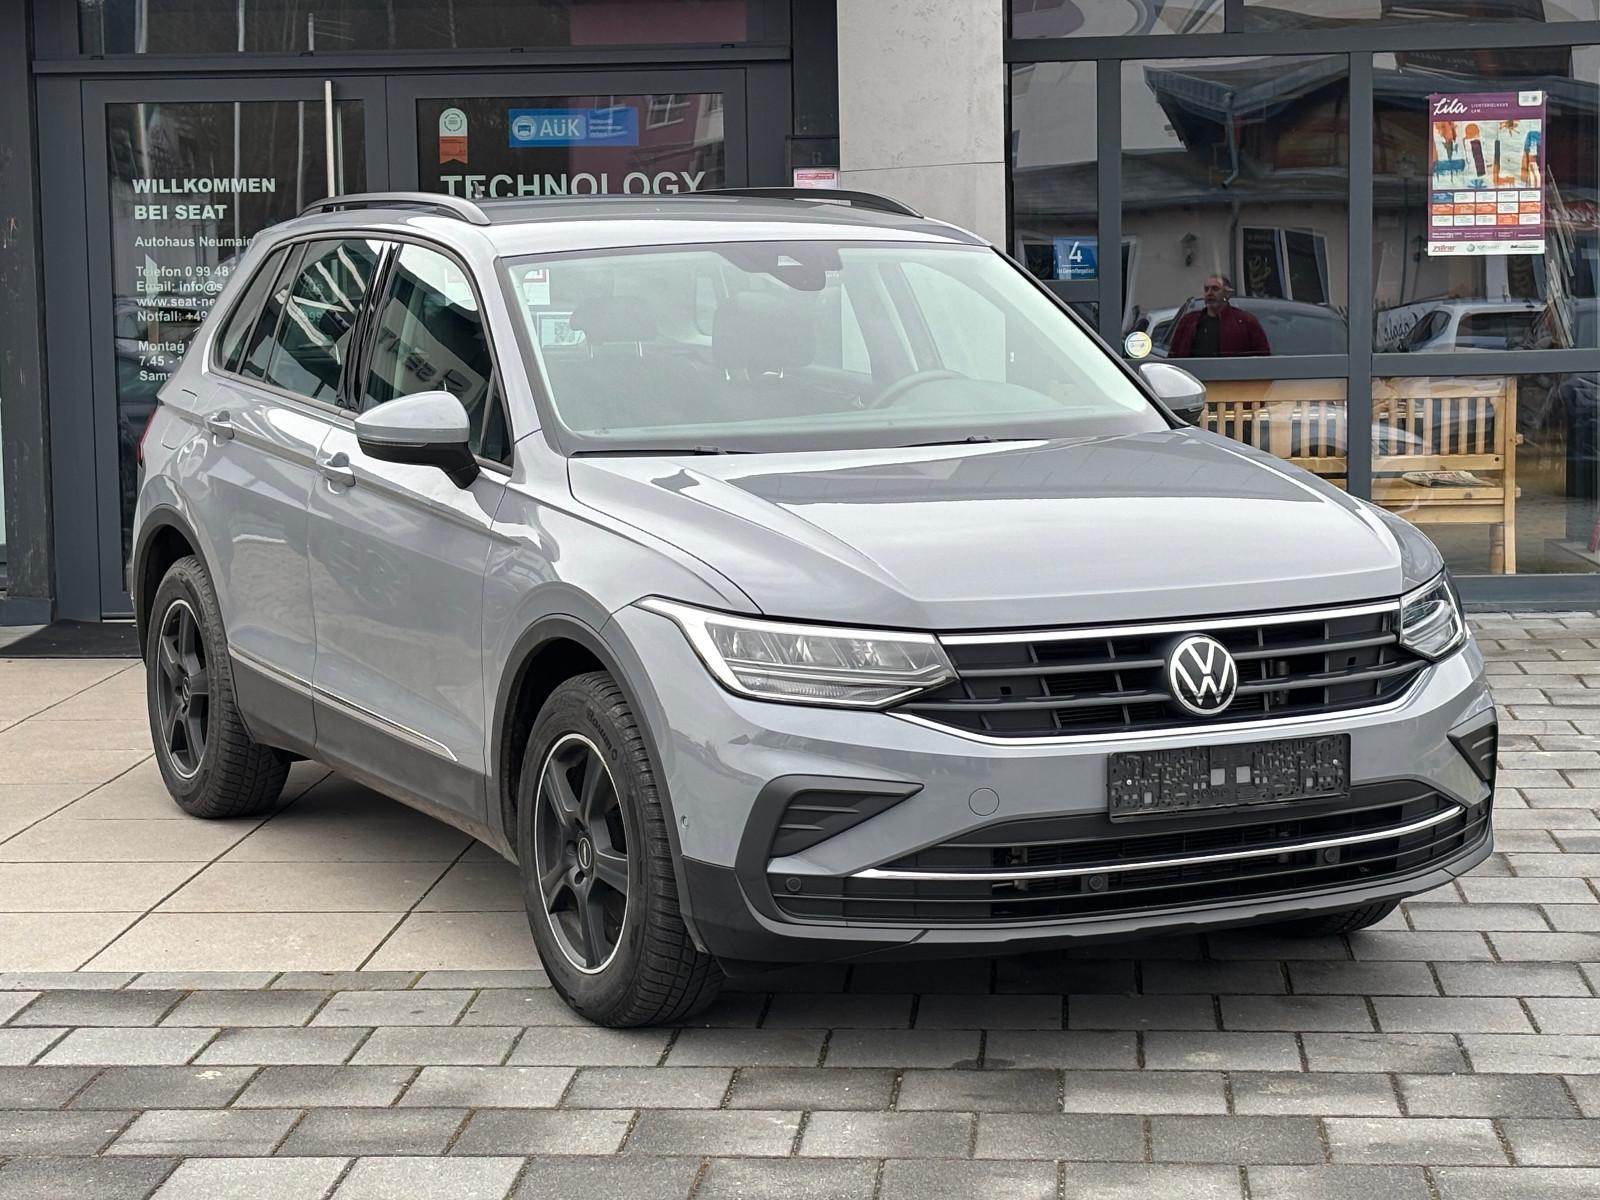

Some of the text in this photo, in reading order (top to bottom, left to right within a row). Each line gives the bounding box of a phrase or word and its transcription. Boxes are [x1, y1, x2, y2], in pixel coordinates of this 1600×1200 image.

[1433, 97, 1468, 116] Lila
[132, 177, 276, 194] WILLKOMMEN
[134, 204, 228, 220] BEI SEAT
[134, 235, 196, 248] Autohaus
[1068, 241, 1083, 263] 4
[184, 266, 193, 277] 0
[195, 266, 211, 277] 99
[213, 266, 230, 277] 48
[137, 311, 182, 322] Notfall:
[138, 341, 185, 354] Montag
[139, 355, 165, 367] 7.45
